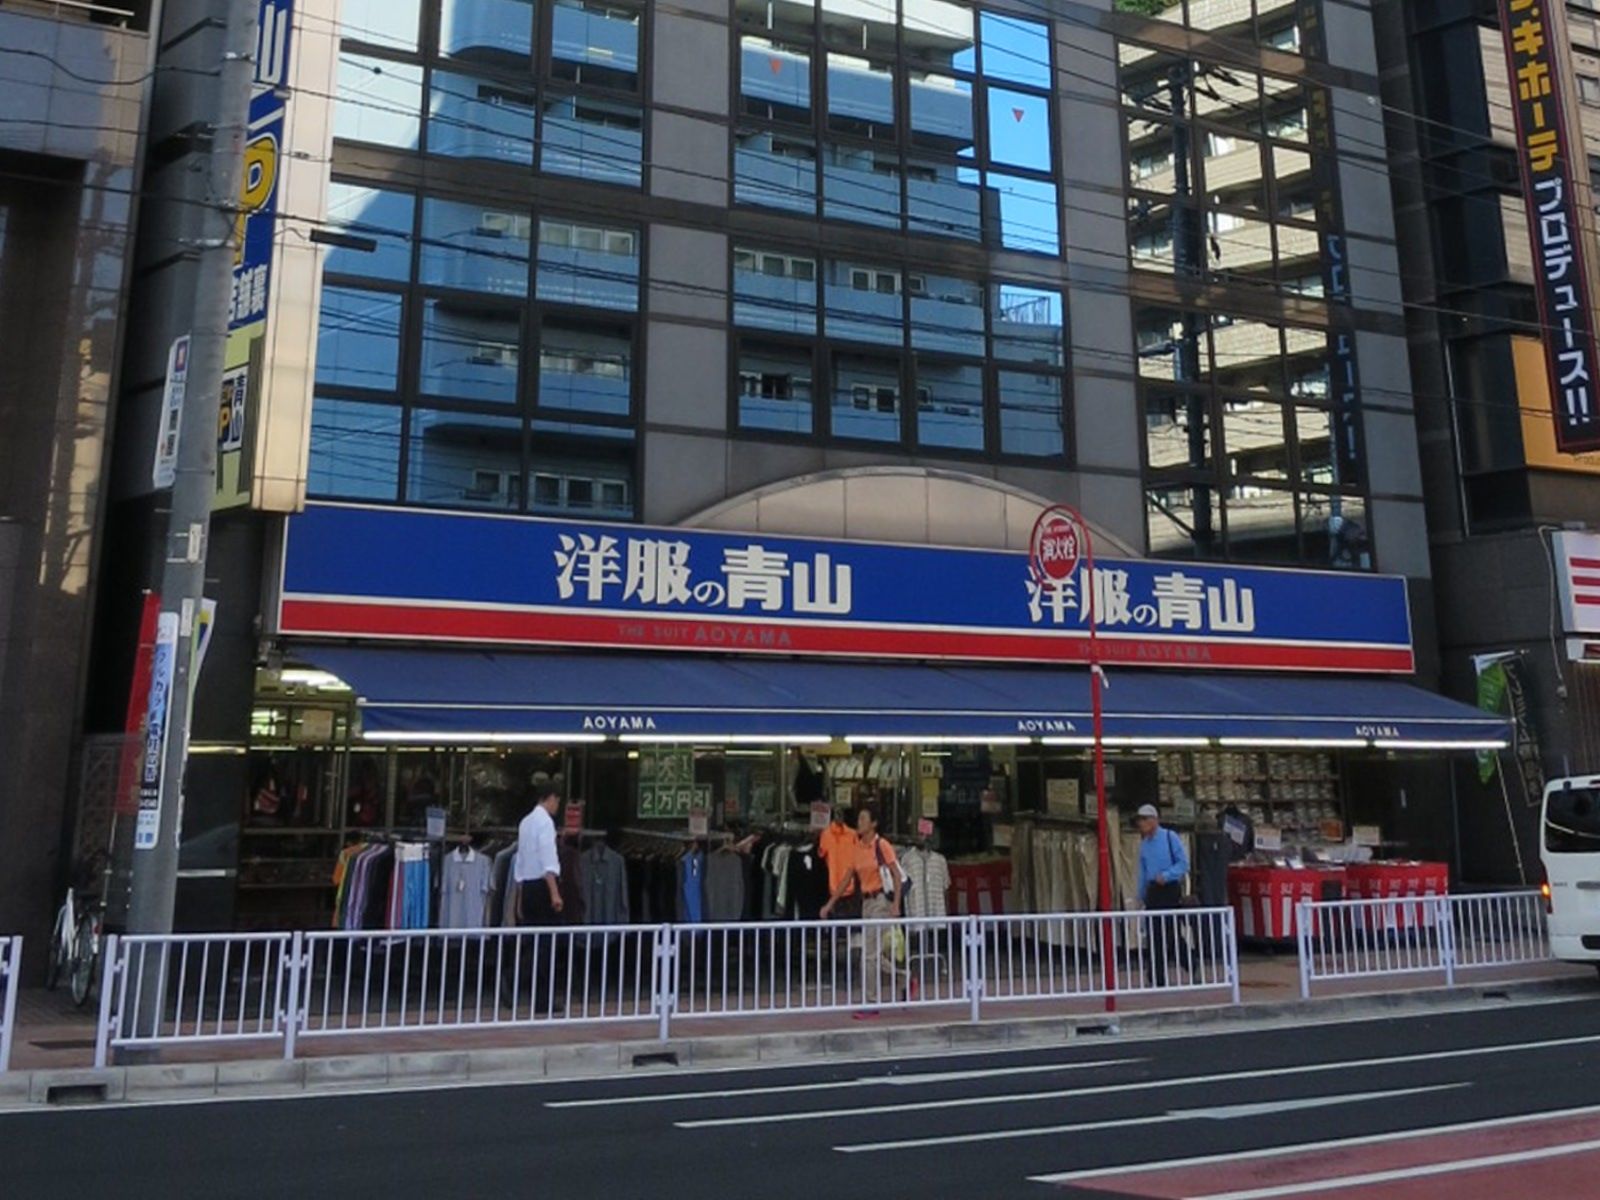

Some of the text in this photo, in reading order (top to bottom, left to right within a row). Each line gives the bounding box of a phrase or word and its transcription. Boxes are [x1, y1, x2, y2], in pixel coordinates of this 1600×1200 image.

[1042, 535, 1076, 562] 消火栓
[554, 533, 852, 614] 洋服の青山
[1024, 565, 1254, 632] 洋服の青山
[696, 625, 792, 646] AOYAMA
[583, 715, 656, 729] AOYAMA
[1018, 720, 1076, 732] AOYAMA
[1355, 725, 1399, 737] AOYAMA
